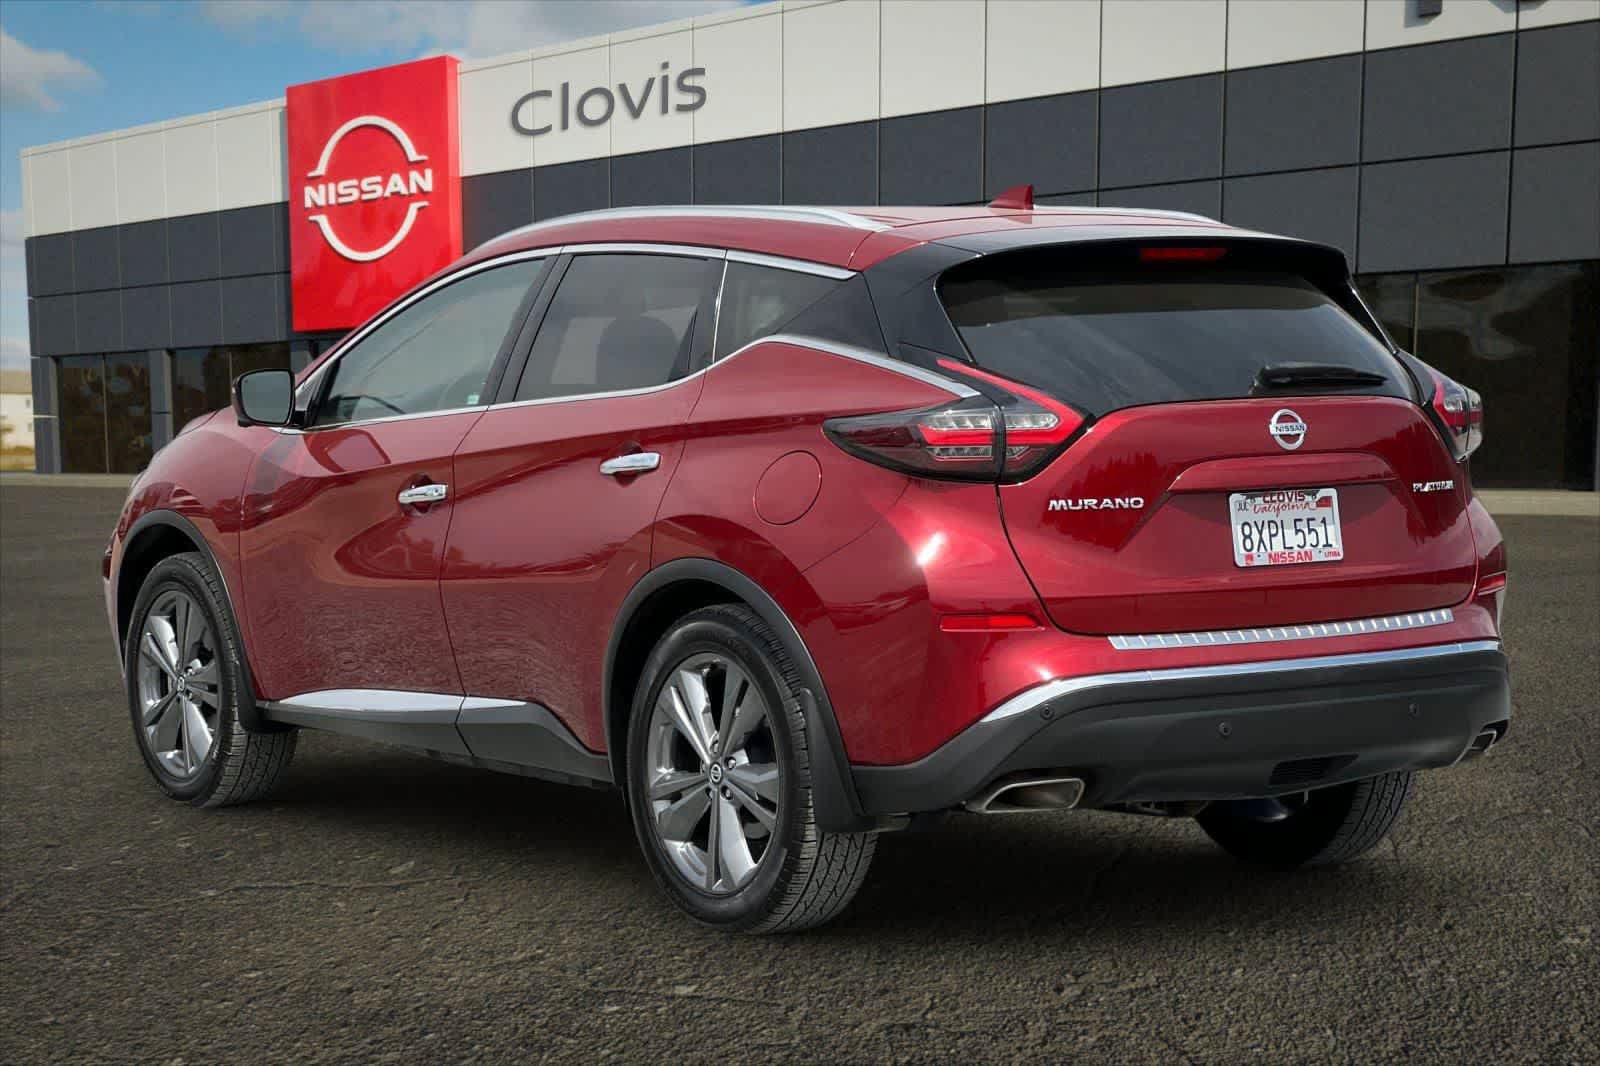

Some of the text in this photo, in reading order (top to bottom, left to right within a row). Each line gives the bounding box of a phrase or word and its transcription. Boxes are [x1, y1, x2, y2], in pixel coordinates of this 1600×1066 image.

[511, 62, 707, 135] Clovis
[304, 168, 432, 208] NISSAN
[1275, 424, 1305, 432] NISSAN
[1048, 497, 1144, 511] MURANO
[1262, 491, 1305, 504] CLOVIS
[1241, 517, 1333, 553] 8XPL551
[1268, 551, 1313, 564] NISSAN
